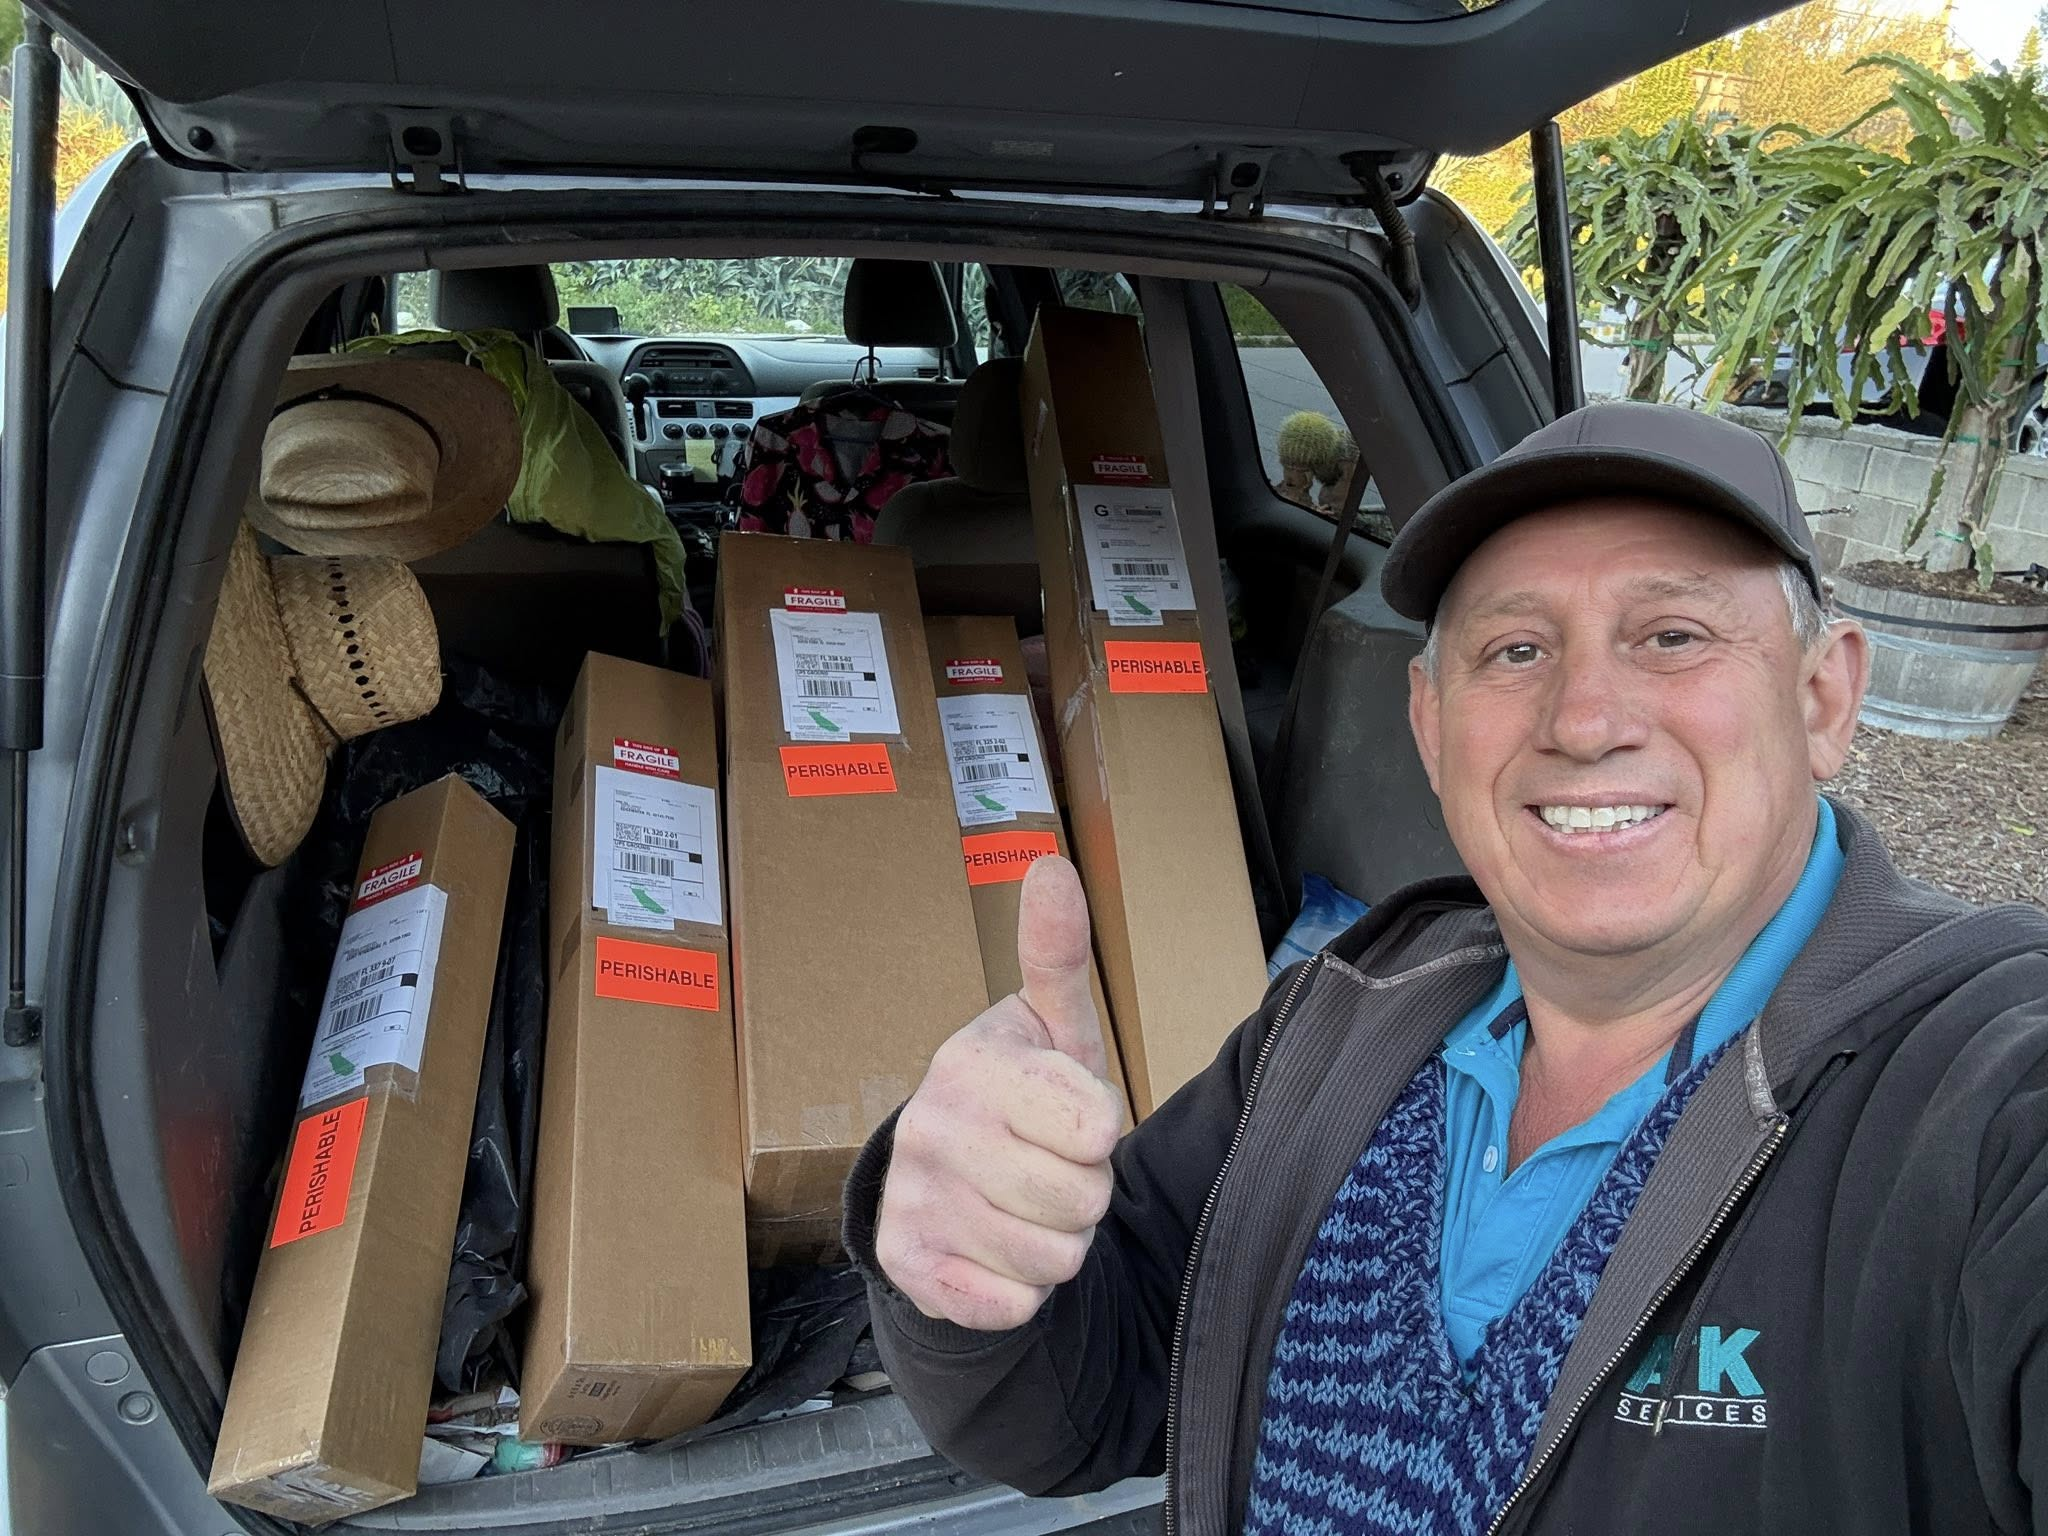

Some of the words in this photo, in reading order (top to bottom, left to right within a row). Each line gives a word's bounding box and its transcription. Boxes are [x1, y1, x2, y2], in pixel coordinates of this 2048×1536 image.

[1098, 464, 1144, 473] FRAGILE
[1094, 504, 1109, 517] G
[790, 596, 841, 606] FRAGILE
[952, 667, 998, 676] FRAGILE
[1111, 659, 1202, 674] PERISHABLE
[620, 749, 674, 768] FRAGILE
[787, 762, 889, 778] PERISHABLE
[643, 827, 651, 835] FL
[651, 828, 664, 837] 320
[664, 830, 678, 839] 2-01
[964, 849, 1056, 867] PERISHAB
[363, 864, 417, 893] FRAGILE
[600, 959, 715, 989] PERISHABLE
[299, 1110, 342, 1234] PERISHABLE
